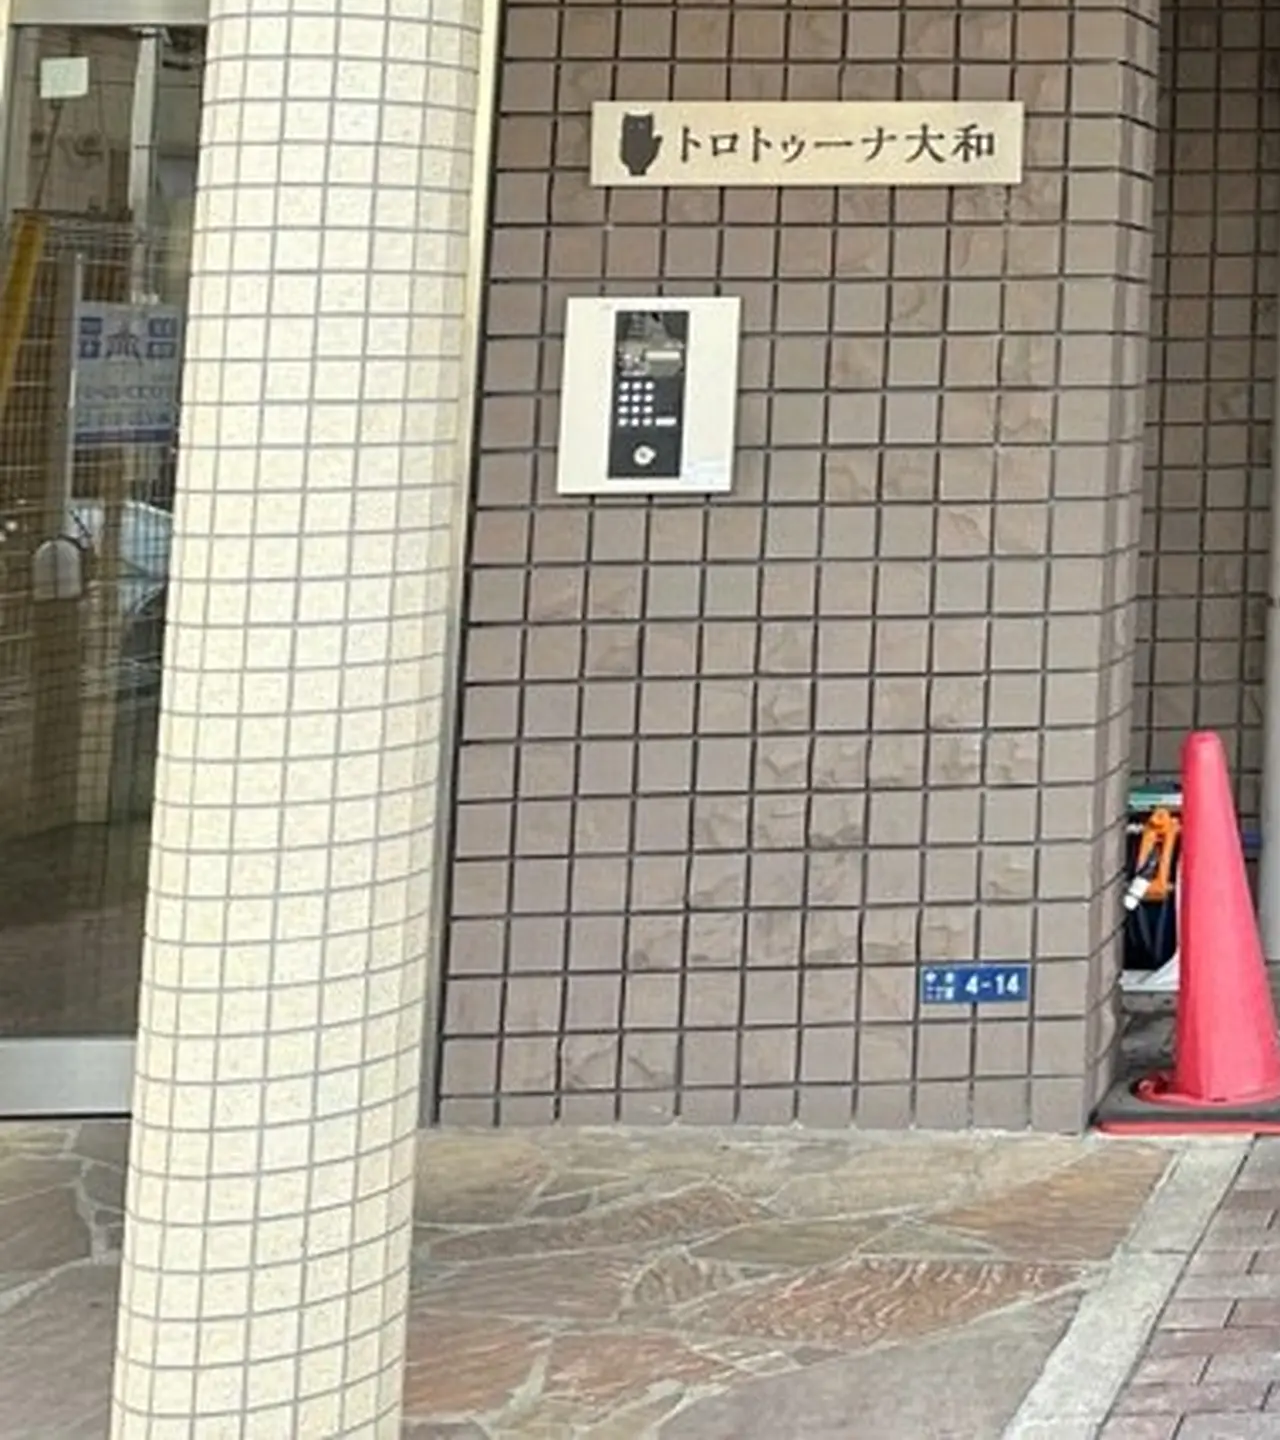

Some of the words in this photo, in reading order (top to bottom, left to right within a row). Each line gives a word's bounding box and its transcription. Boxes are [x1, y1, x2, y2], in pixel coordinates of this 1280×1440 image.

[679, 122, 996, 164] トロトゥーナ大和
